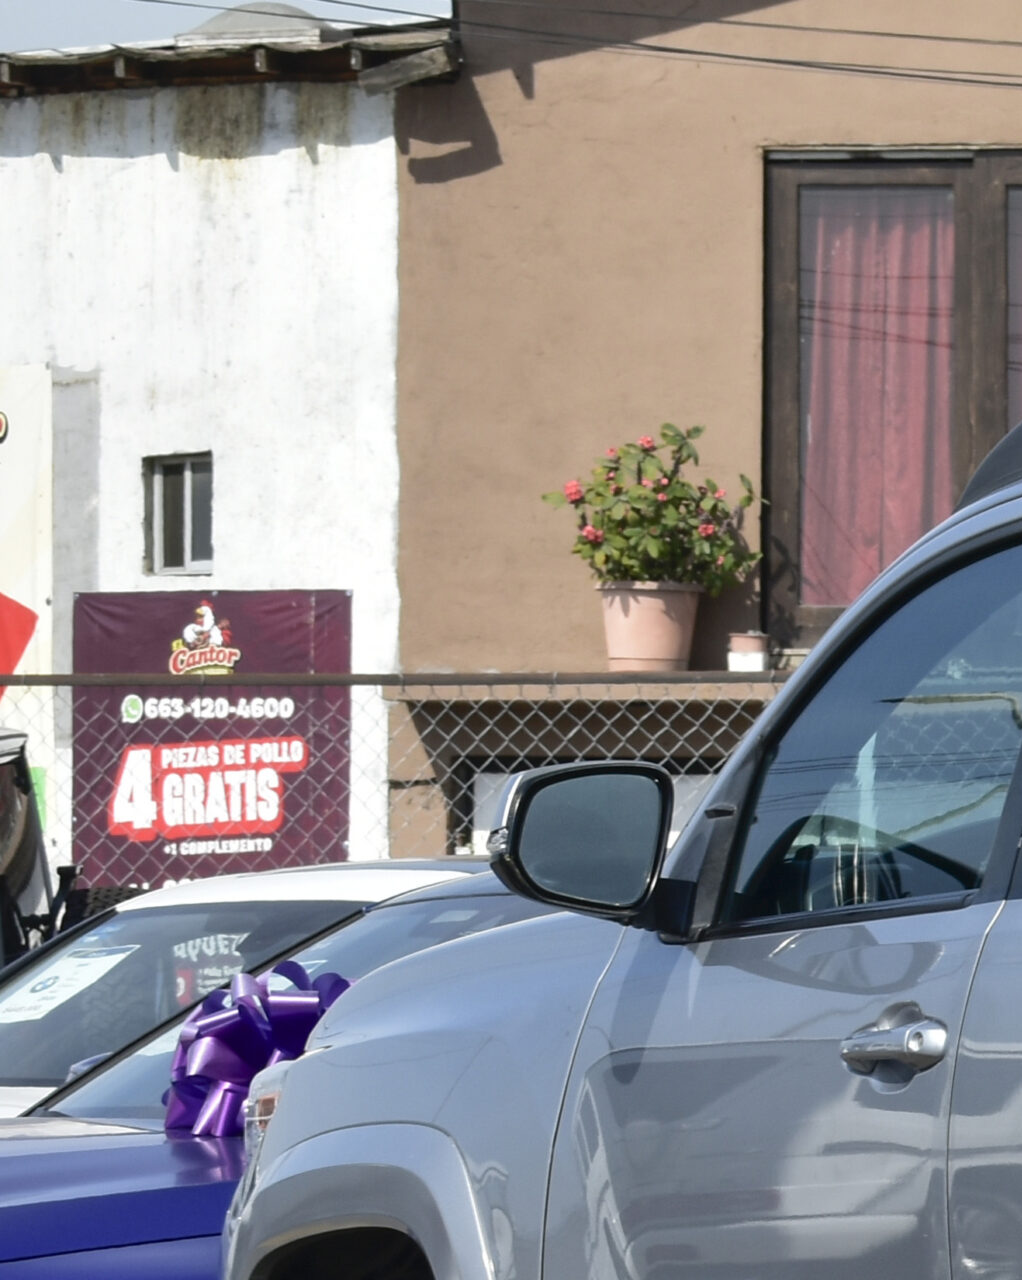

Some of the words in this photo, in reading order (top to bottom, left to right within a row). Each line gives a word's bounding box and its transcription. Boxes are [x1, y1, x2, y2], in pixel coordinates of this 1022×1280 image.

[169, 645, 241, 675] Cantor
[145, 697, 295, 719] 663-120-4600
[161, 745, 220, 769] PIEZAS
[223, 744, 246, 765] DE
[250, 740, 304, 764] POLLO
[113, 749, 157, 829] 4
[162, 767, 280, 827] GRATIS
[180, 837, 273, 856] COMPLEMENTO
